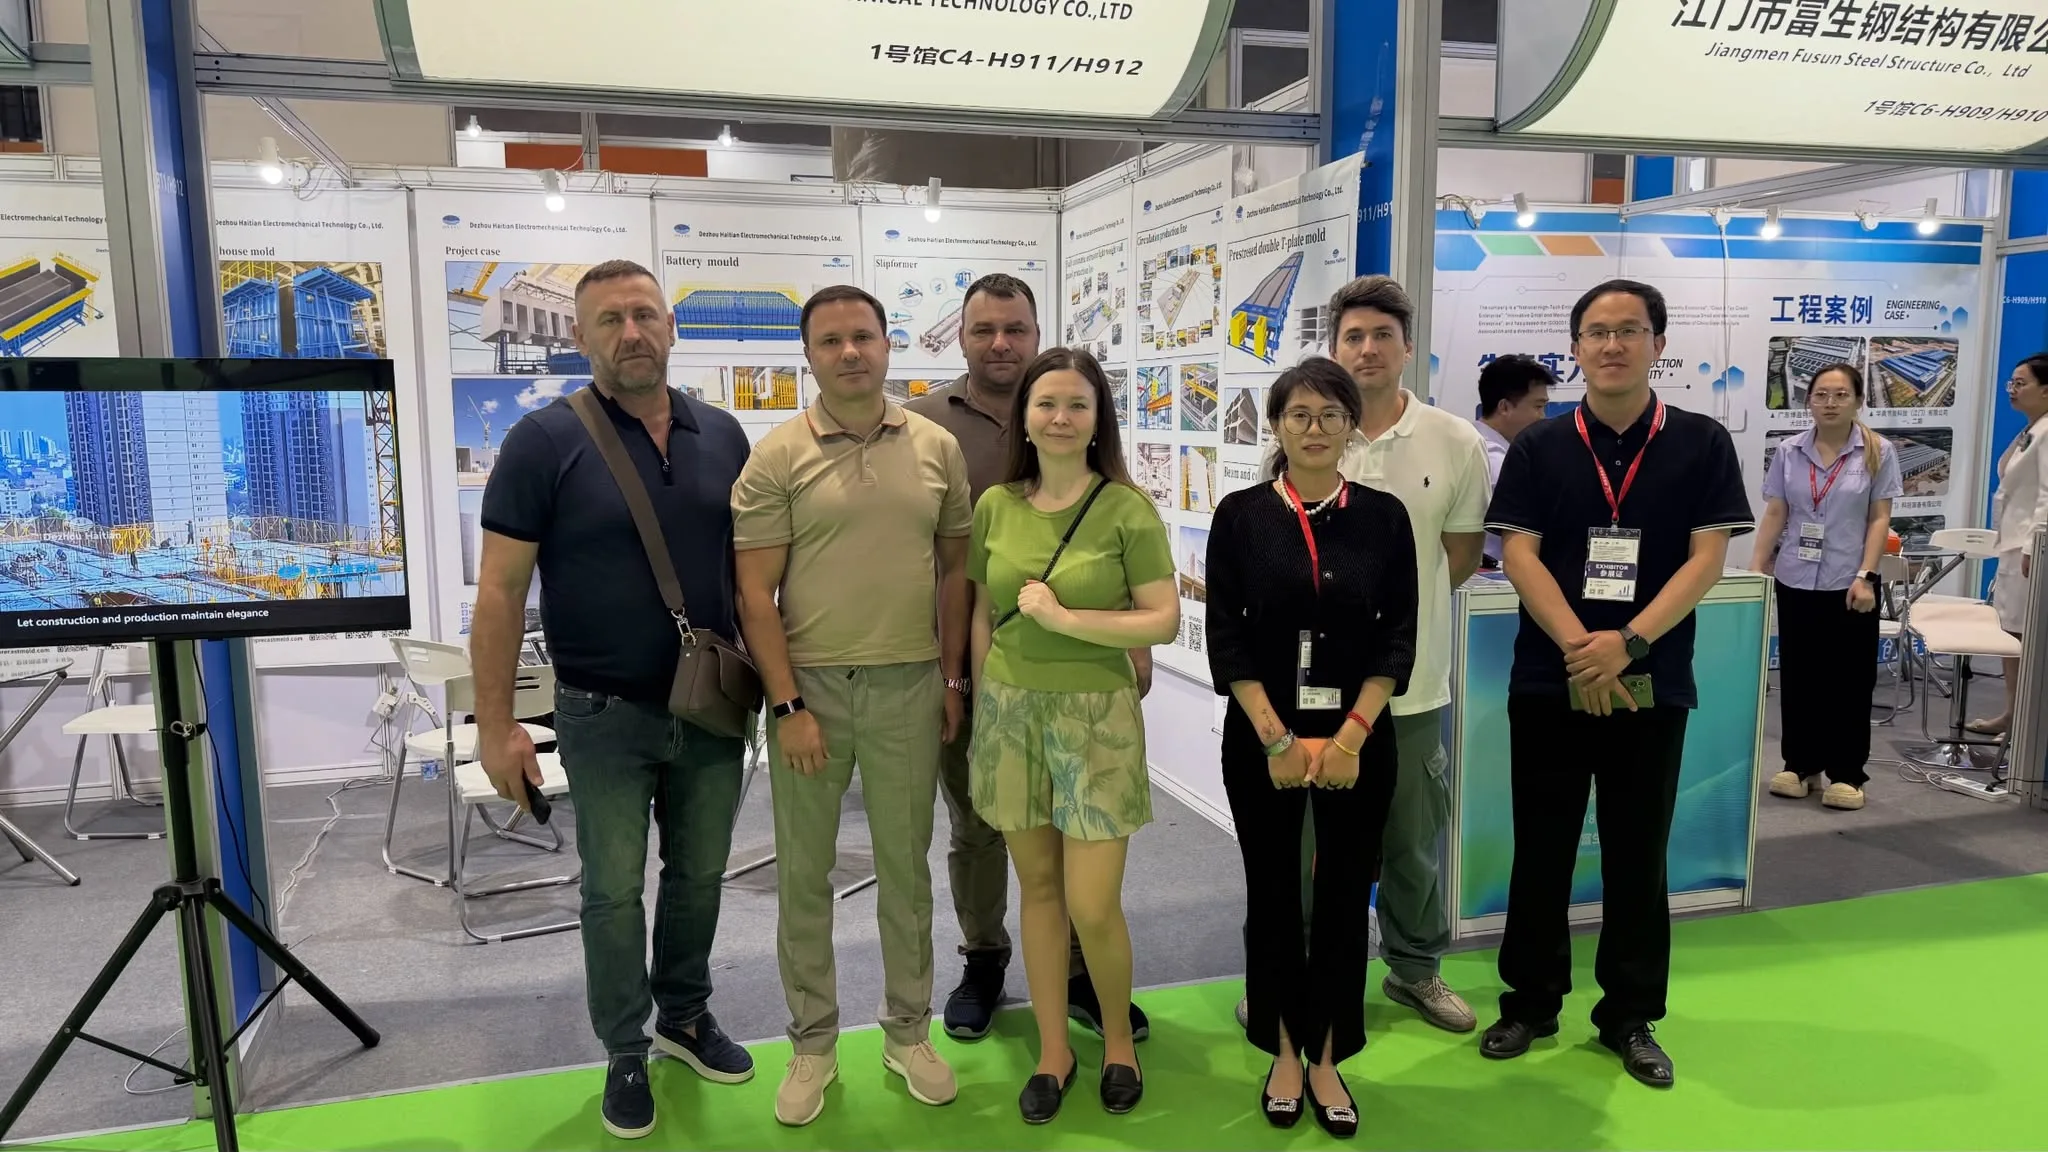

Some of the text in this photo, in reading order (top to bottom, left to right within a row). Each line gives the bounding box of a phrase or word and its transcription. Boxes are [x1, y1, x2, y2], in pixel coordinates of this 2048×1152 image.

[1063, 0, 1133, 20] CO.,LTD
[870, 44, 1144, 76] 1号馆C4-H911/H912
[1705, 42, 2032, 78] Jiangmen Fusun Steel Structure Co., Ltd
[1864, 99, 2048, 124] 1号馆C6-H909/H910
[1301, 191, 1324, 203] Technology
[0, 213, 63, 223] Electromechanical
[64, 215, 104, 225] Technology
[238, 219, 262, 227] Haitian
[262, 220, 321, 229] Electromechanical
[321, 222, 357, 230] Technology
[371, 222, 384, 230] Ltd.
[469, 221, 492, 229] Dezhou
[492, 222, 514, 230] Haitian
[515, 223, 569, 231] Electromechanical
[569, 225, 602, 234] Technology
[698, 230, 719, 238] Dezhou
[740, 232, 789, 240] Electromechanical
[790, 234, 820, 242] Technology
[990, 238, 1018, 247] Technology
[1028, 239, 1038, 247] Ltd.
[1258, 238, 1280, 255] double
[1281, 233, 1305, 252] T-plate
[1305, 227, 1326, 245] mold
[219, 246, 275, 257] house mold
[445, 245, 501, 258] Project case
[665, 255, 740, 269] Battery mould
[875, 258, 918, 270] Slipformer
[1769, 294, 1873, 325] 工程案例
[1885, 299, 1940, 310] ENGINEERING
[1884, 310, 1905, 320] CASE
[1224, 466, 1239, 479] Beam
[1240, 468, 1251, 481] and
[1600, 569, 1624, 578] 参展证
[17, 607, 269, 628] Let construction and production maintain elegance
